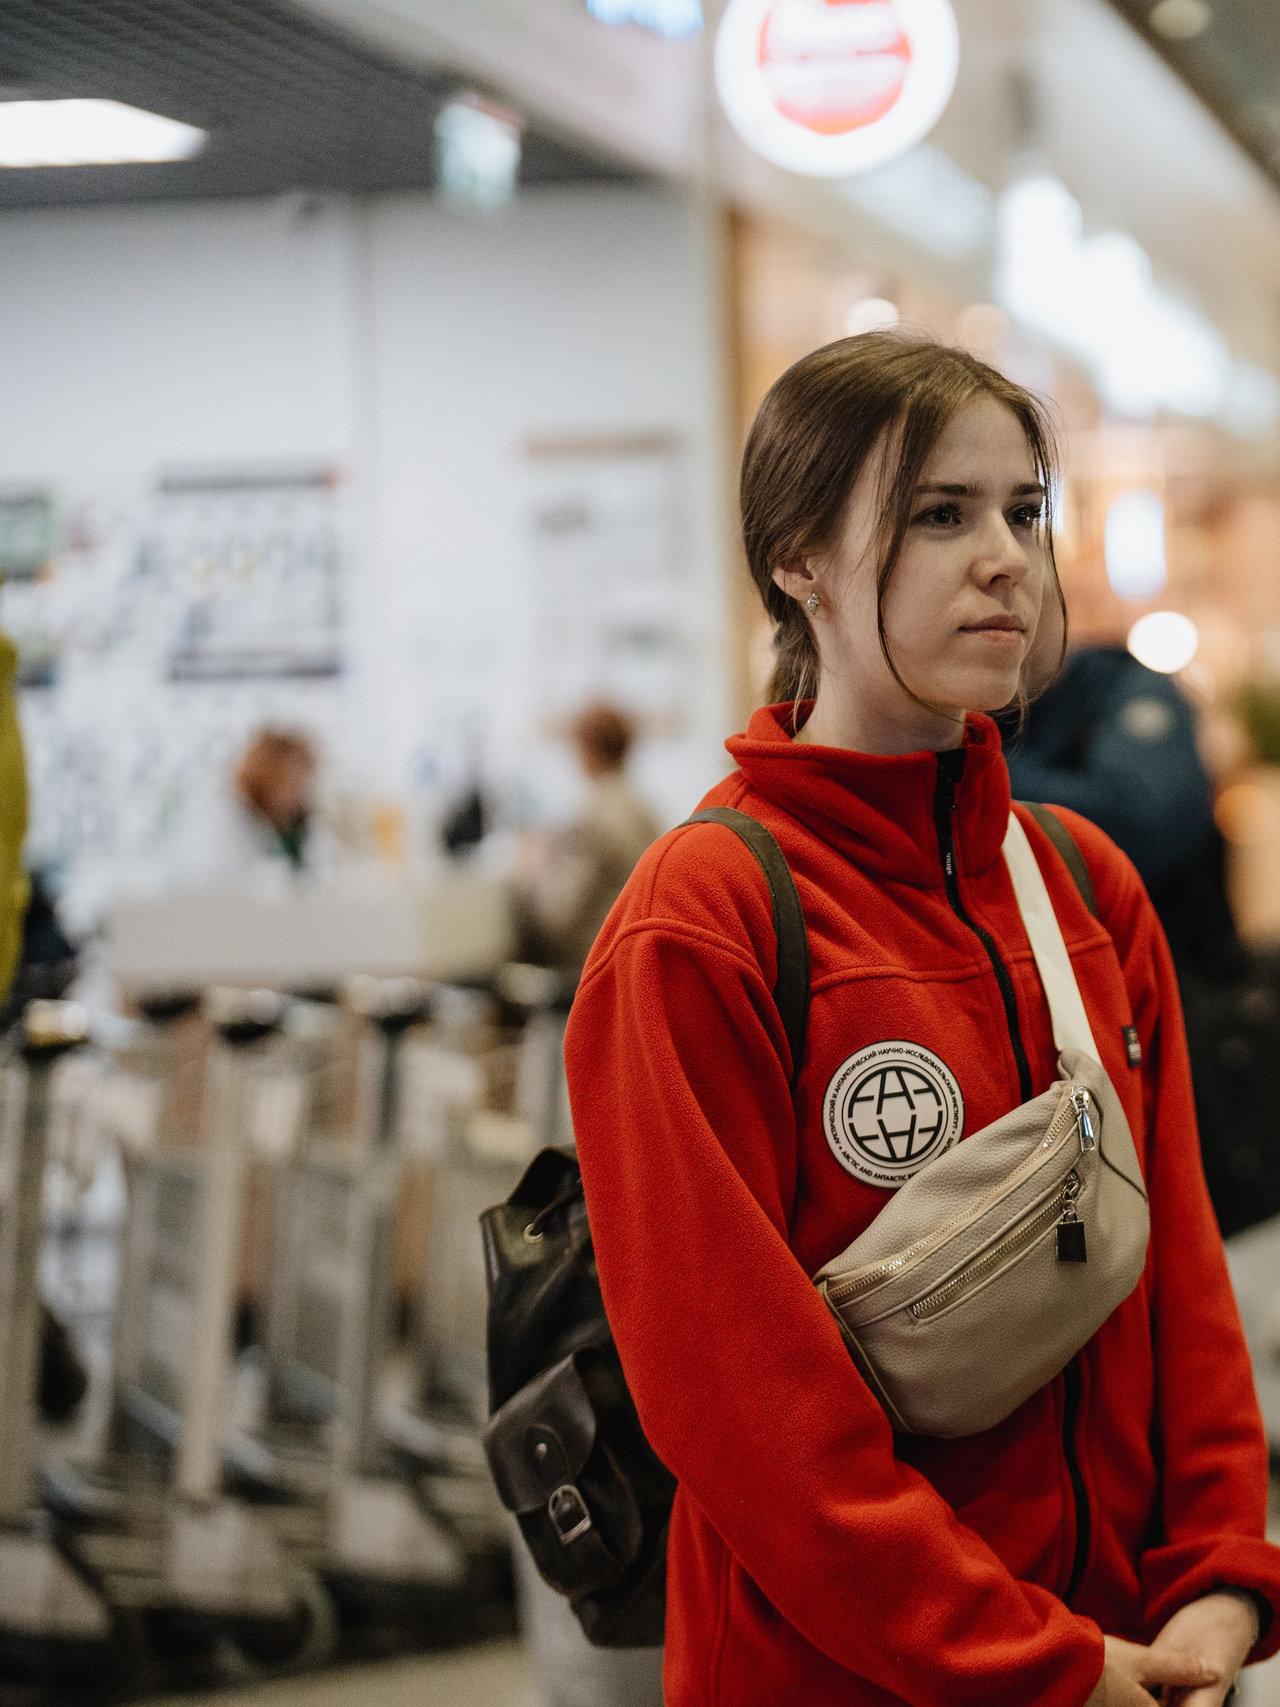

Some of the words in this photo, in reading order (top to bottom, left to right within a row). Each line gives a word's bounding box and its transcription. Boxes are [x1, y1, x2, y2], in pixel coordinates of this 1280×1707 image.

[834, 1050, 878, 1094] АНТАРКТИЧЕСКИЙ
[877, 1047, 956, 1096] НАУЧНО-ИССЛЕДОВАТЕЛЬСКИЙ
[828, 1098, 841, 1144] АРКТИЧЕСКИЙ
[951, 1095, 959, 1130] ИНСТИТУТ
[842, 1150, 860, 1170] ARCTIC
[859, 1166, 873, 1176] AND
[873, 1172, 908, 1182] ANTARCTIC
